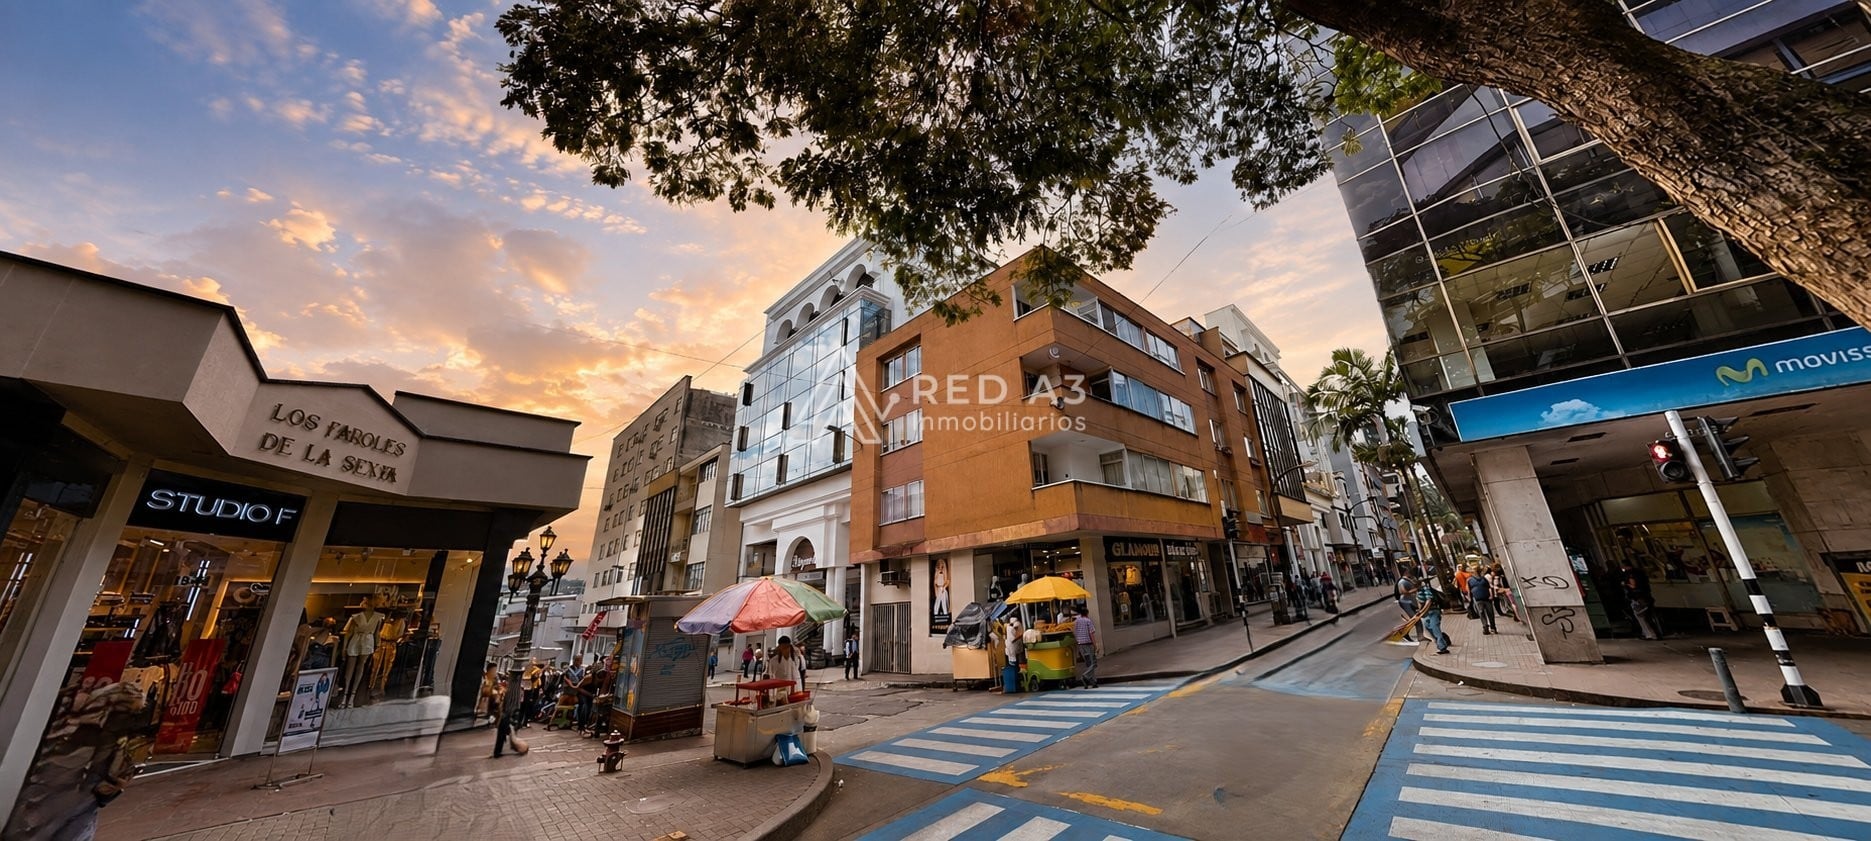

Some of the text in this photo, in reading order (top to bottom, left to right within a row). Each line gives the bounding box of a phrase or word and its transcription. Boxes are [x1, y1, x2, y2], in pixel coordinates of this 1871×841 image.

[271, 403, 406, 456] LOS FAROLES
[259, 432, 295, 456] DE
[304, 444, 331, 467] LA
[146, 489, 297, 525] STUDIO F
[1112, 542, 1161, 556] GLAMOUR
